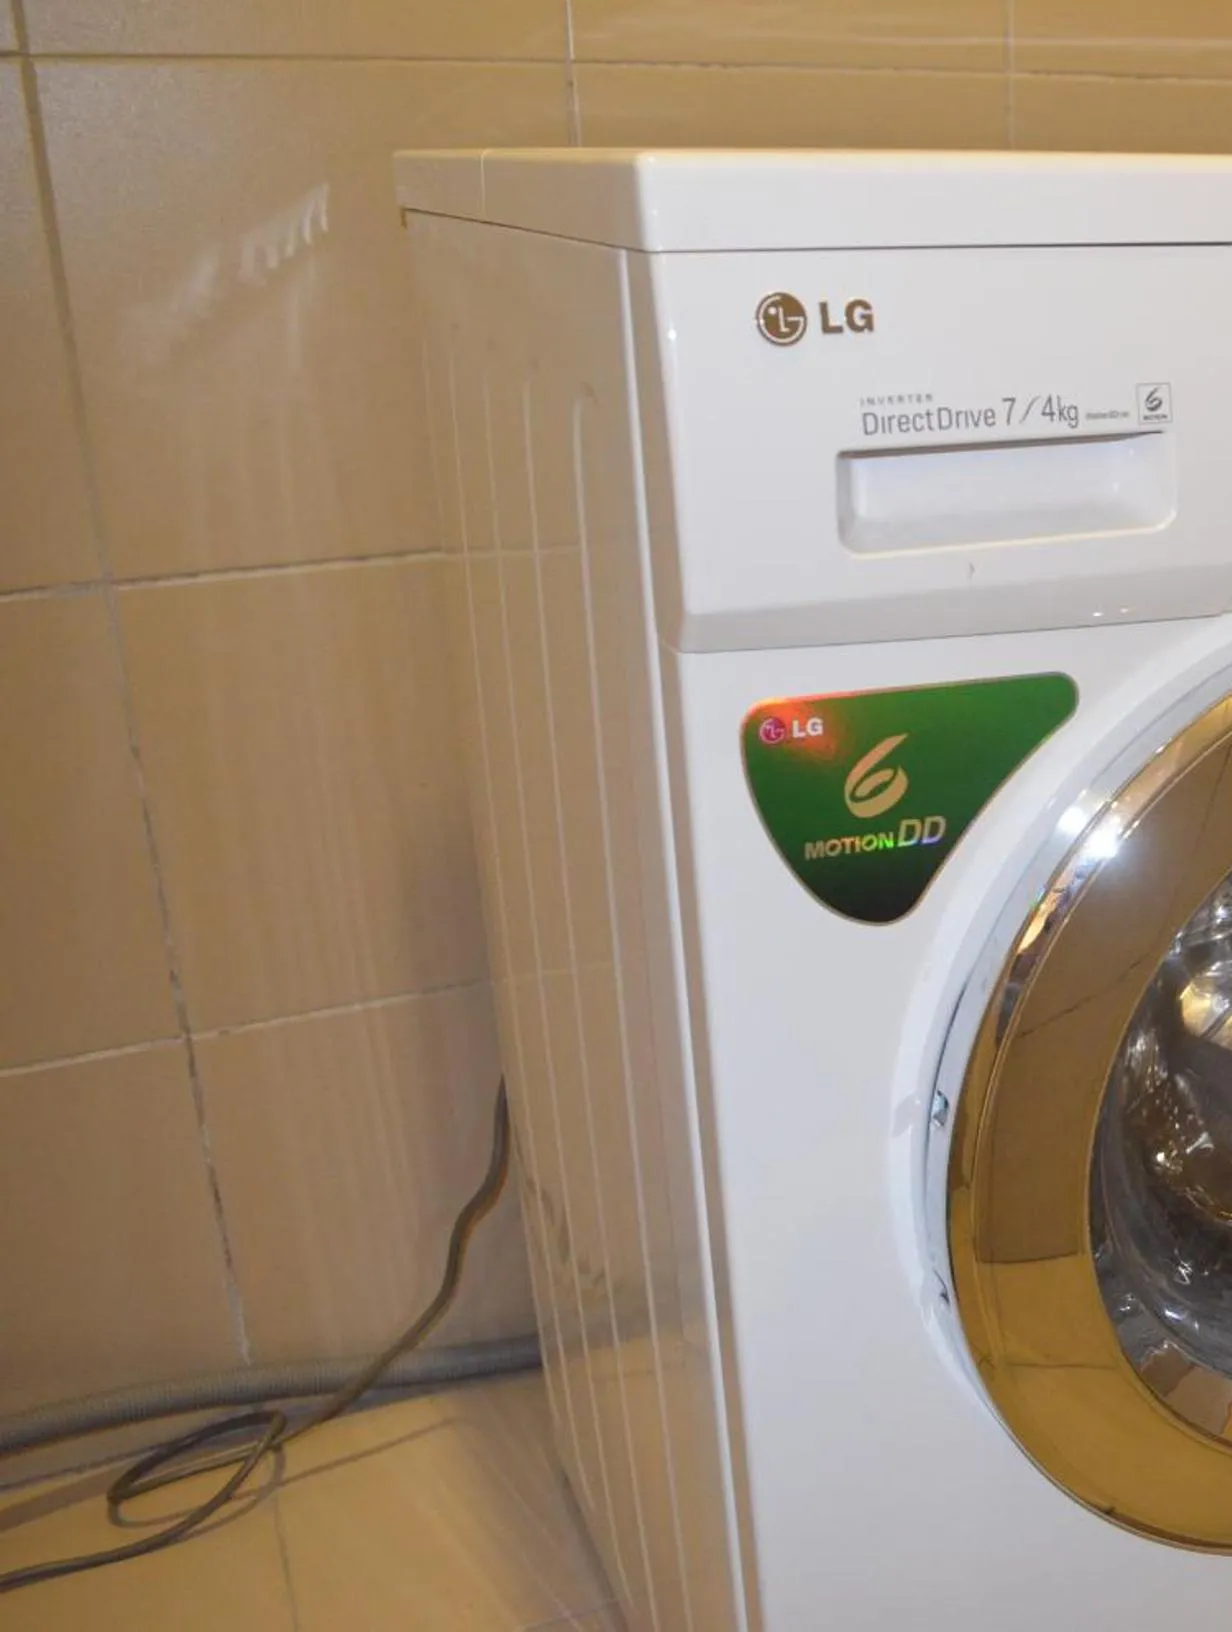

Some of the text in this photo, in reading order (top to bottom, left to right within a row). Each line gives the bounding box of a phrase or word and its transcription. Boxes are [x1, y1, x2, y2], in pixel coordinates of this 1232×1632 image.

[818, 299, 875, 335] LG
[859, 393, 933, 408] INVERTER
[792, 717, 823, 738] LG
[844, 732, 909, 819] 6
[804, 815, 947, 861] MOTION DD
